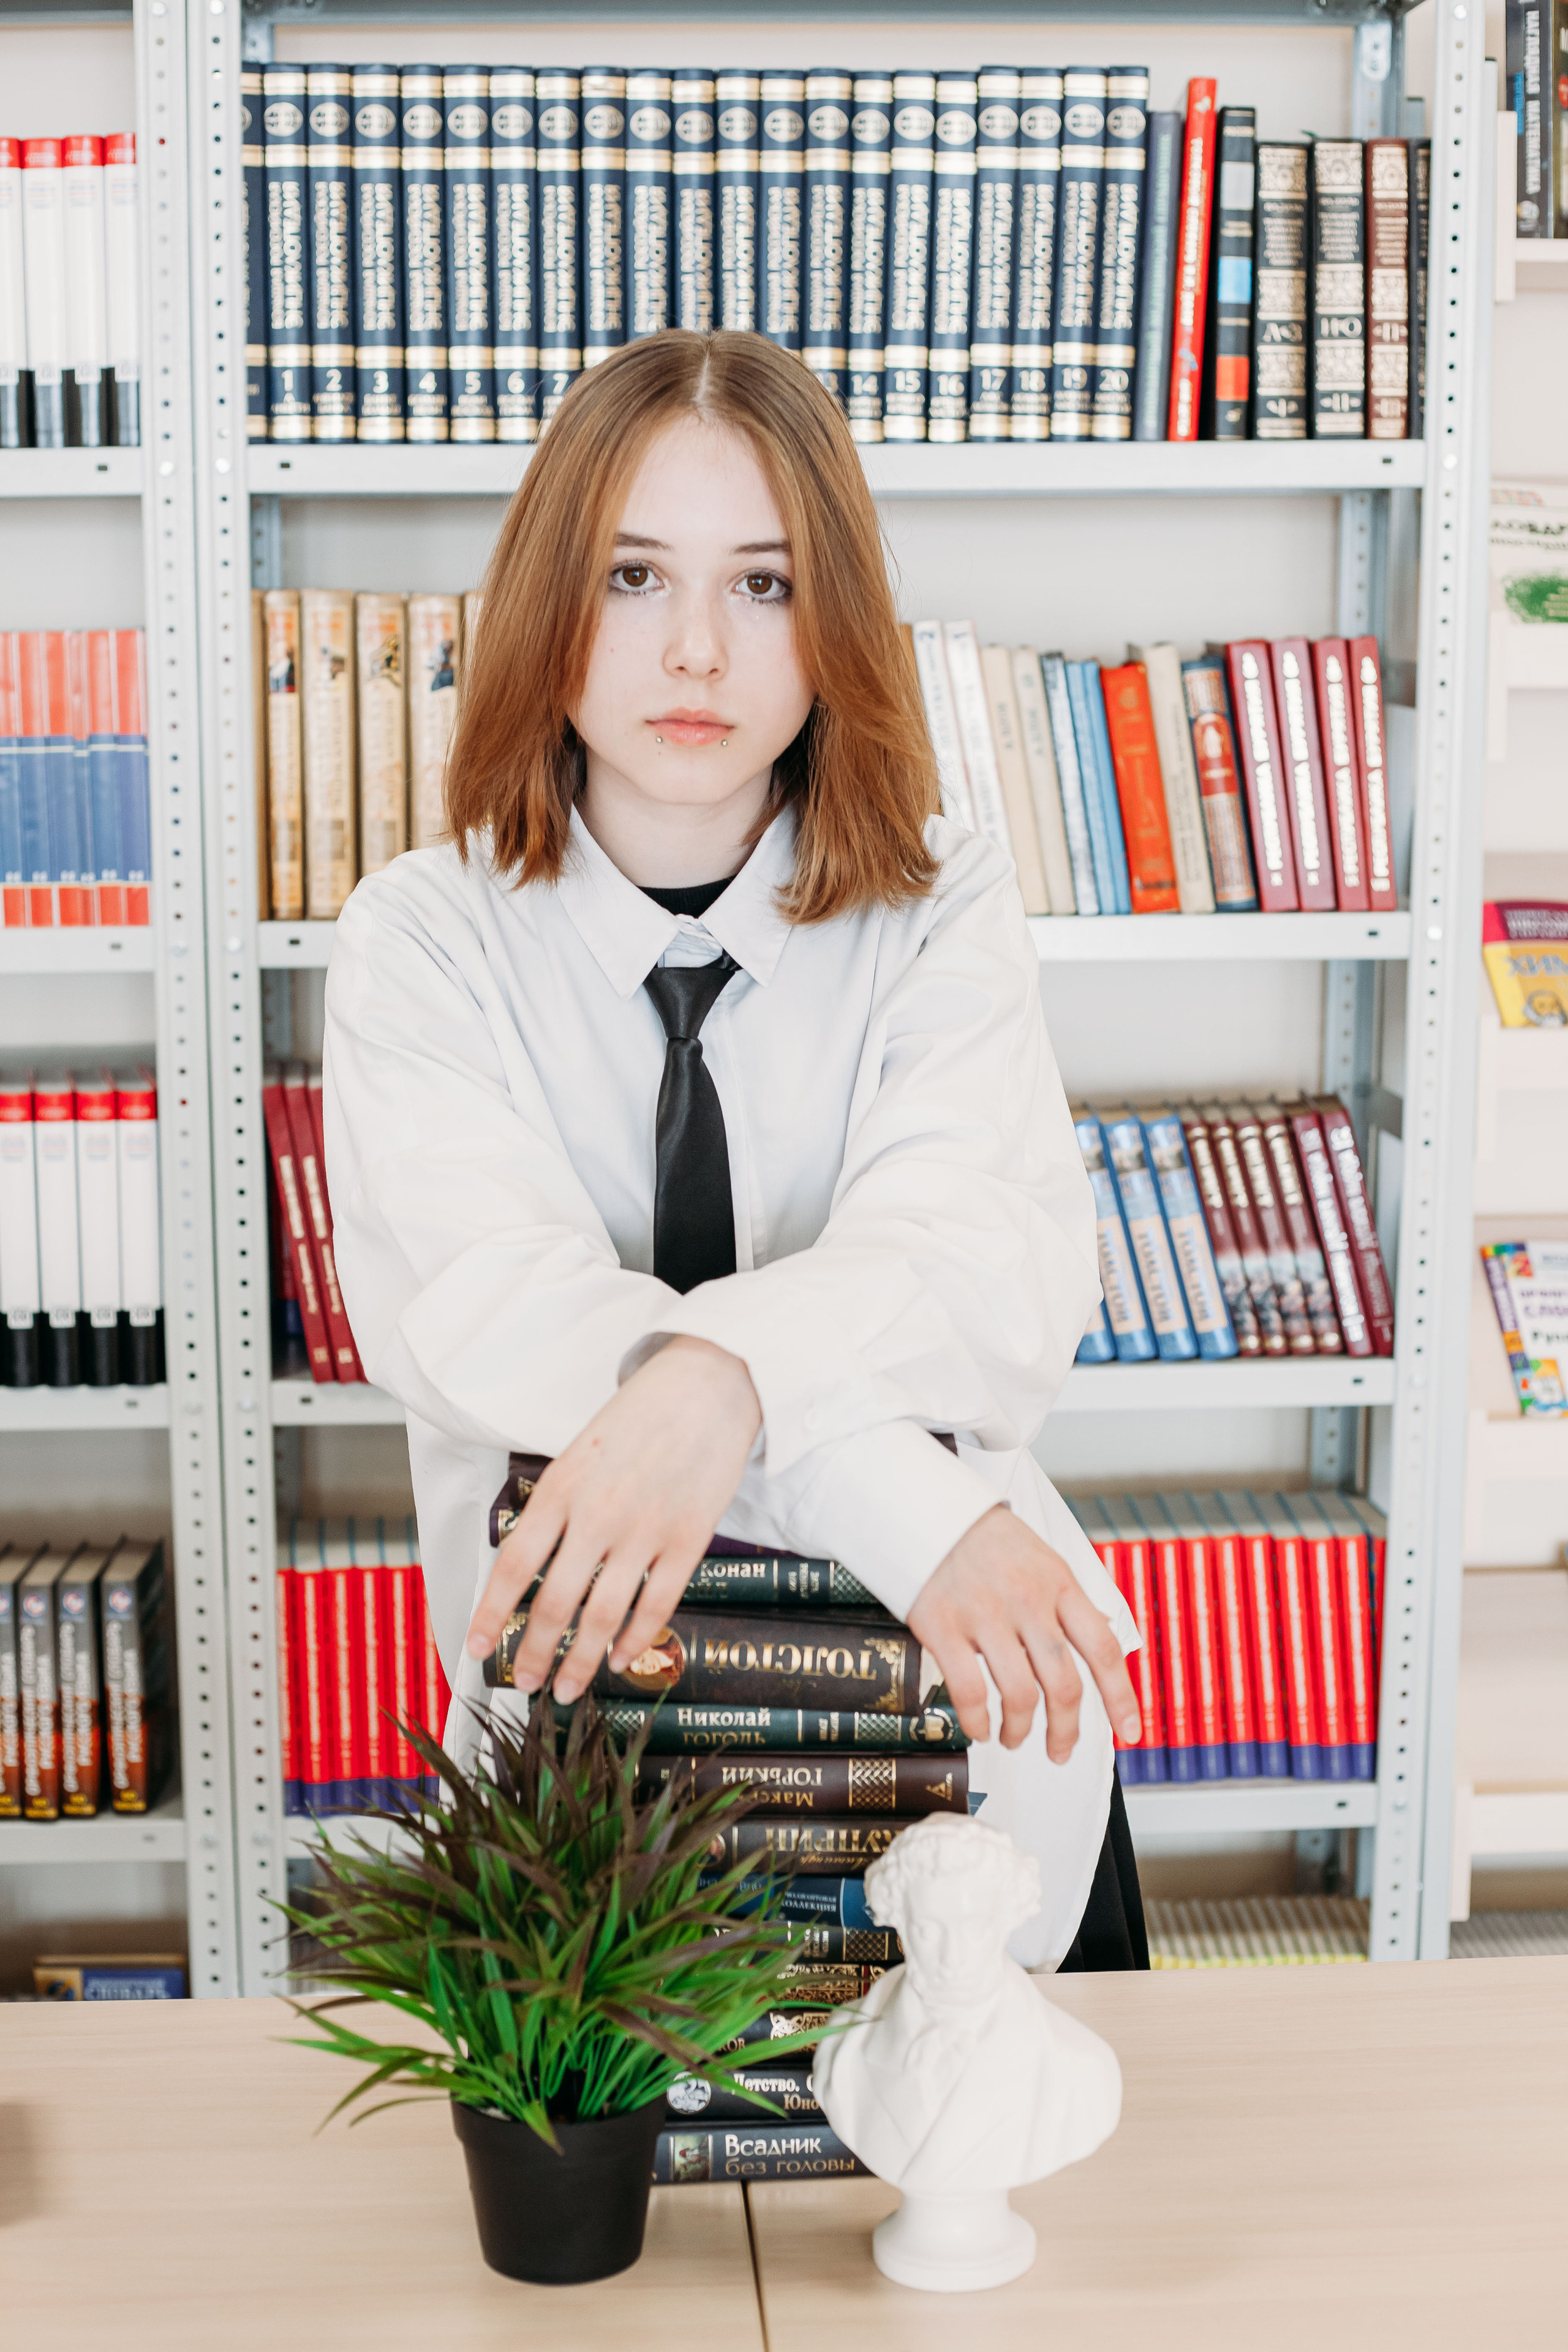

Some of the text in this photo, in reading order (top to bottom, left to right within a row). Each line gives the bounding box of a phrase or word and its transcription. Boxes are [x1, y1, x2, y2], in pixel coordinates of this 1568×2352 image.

[1525, 100, 1541, 194] МАТЕМАТИКА
[282, 182, 303, 327] ЭНЦИКЛОПЕДИЯ
[330, 182, 348, 328] ЭНЦИКЛОПЕДИЯ
[375, 183, 395, 329] ЭНЦИКЛОПЕДИЯ
[423, 184, 442, 329] ЭНЦИКЛОПЕДИЯ
[467, 184, 488, 330] ЭНЦИКЛОПЕДИЯ
[511, 184, 530, 330] ЭНЦИКЛОПЕДИЯ
[557, 186, 575, 331] ЭНЦИКЛОПЕДИЯ
[605, 184, 621, 330] ЭНЦИКЛОПЕДИЯ
[649, 186, 667, 331] ЭНЦИКЛОПЕДИЯ
[695, 189, 712, 331] ЭНЦИКЛОПЕДИЯ
[736, 186, 755, 331] ЭНЦИКЛОПЕДИЯ
[782, 187, 799, 331] ЭНЦИКЛОПЕДИЯ
[823, 185, 843, 330] ЭНЦИКЛОПЕДИЯ
[864, 188, 884, 333] ЭНЦИКЛОПЕДИЯ
[907, 184, 929, 330] ЭНЦИКЛОПЕДИЯ
[950, 189, 971, 333] ЭНЦИКЛОПЕДИЯ
[992, 183, 1012, 327] ЭНЦИКЛОПЕДИЯ
[1031, 184, 1054, 329] ЭНЦИКЛОПЕДИЯ
[1075, 182, 1097, 326] ЭНЦИКЛОПЕДИЯ
[1114, 184, 1138, 328] ЭНЦИКЛОПЕДИЯ
[282, 371, 293, 391] 1
[326, 369, 341, 391] 2
[374, 371, 388, 393] 3
[420, 372, 437, 393] 4
[466, 372, 481, 394] 5
[508, 372, 524, 393] 6
[554, 374, 568, 394] 7
[853, 375, 878, 395] 14
[895, 371, 921, 392] 15
[938, 375, 964, 396] 16
[981, 369, 1007, 390] 17
[1020, 371, 1046, 392] 18
[1063, 368, 1088, 390] 19
[1100, 369, 1129, 391] 20
[677, 1707, 772, 1728] Николай
[704, 1638, 877, 1680] ТОЛСТОЙ
[724, 2133, 822, 2157] Всадник
[725, 2157, 856, 2176] без головы
